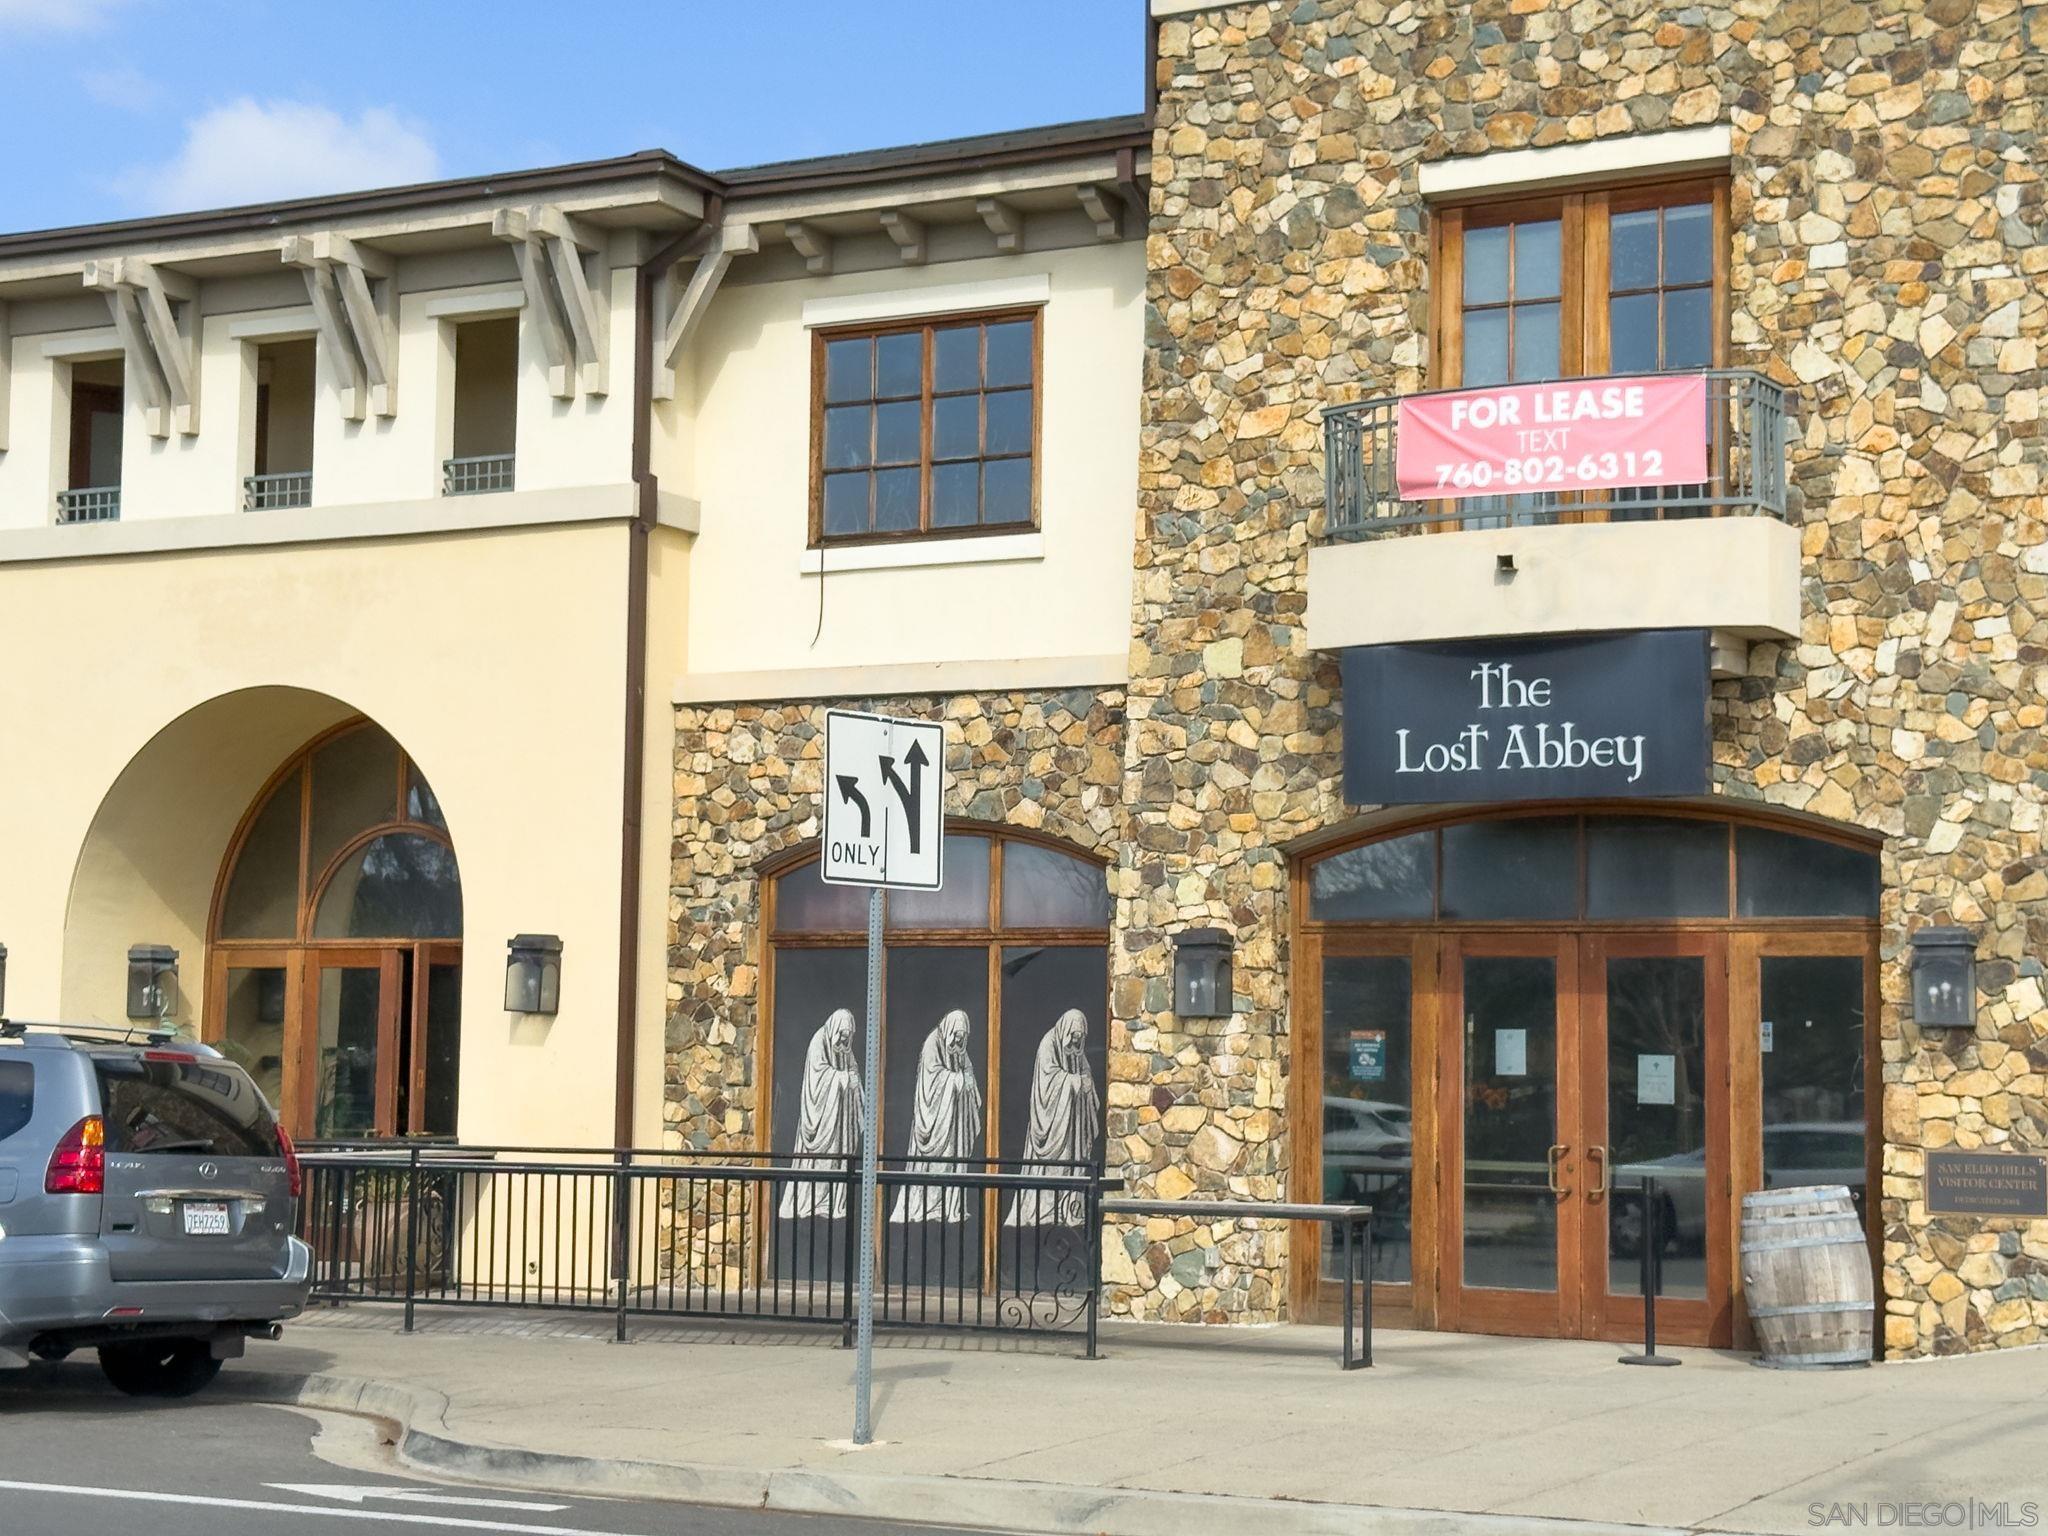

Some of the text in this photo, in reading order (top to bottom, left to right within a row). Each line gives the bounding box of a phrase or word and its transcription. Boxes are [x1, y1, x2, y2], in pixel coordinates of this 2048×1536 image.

[1451, 386, 1645, 431] FOR LEASE
[1517, 428, 1571, 453] TEXT
[1435, 449, 1664, 489] 760-802-6312
[1470, 662, 1551, 709] The
[1395, 721, 1646, 783] Lost Abbey
[831, 841, 881, 866] ONLY
[1937, 1163, 1962, 1175] SAN
[2001, 1165, 2037, 1176] HILLS
[1938, 1177, 2038, 1190] VISITOR CENTER
